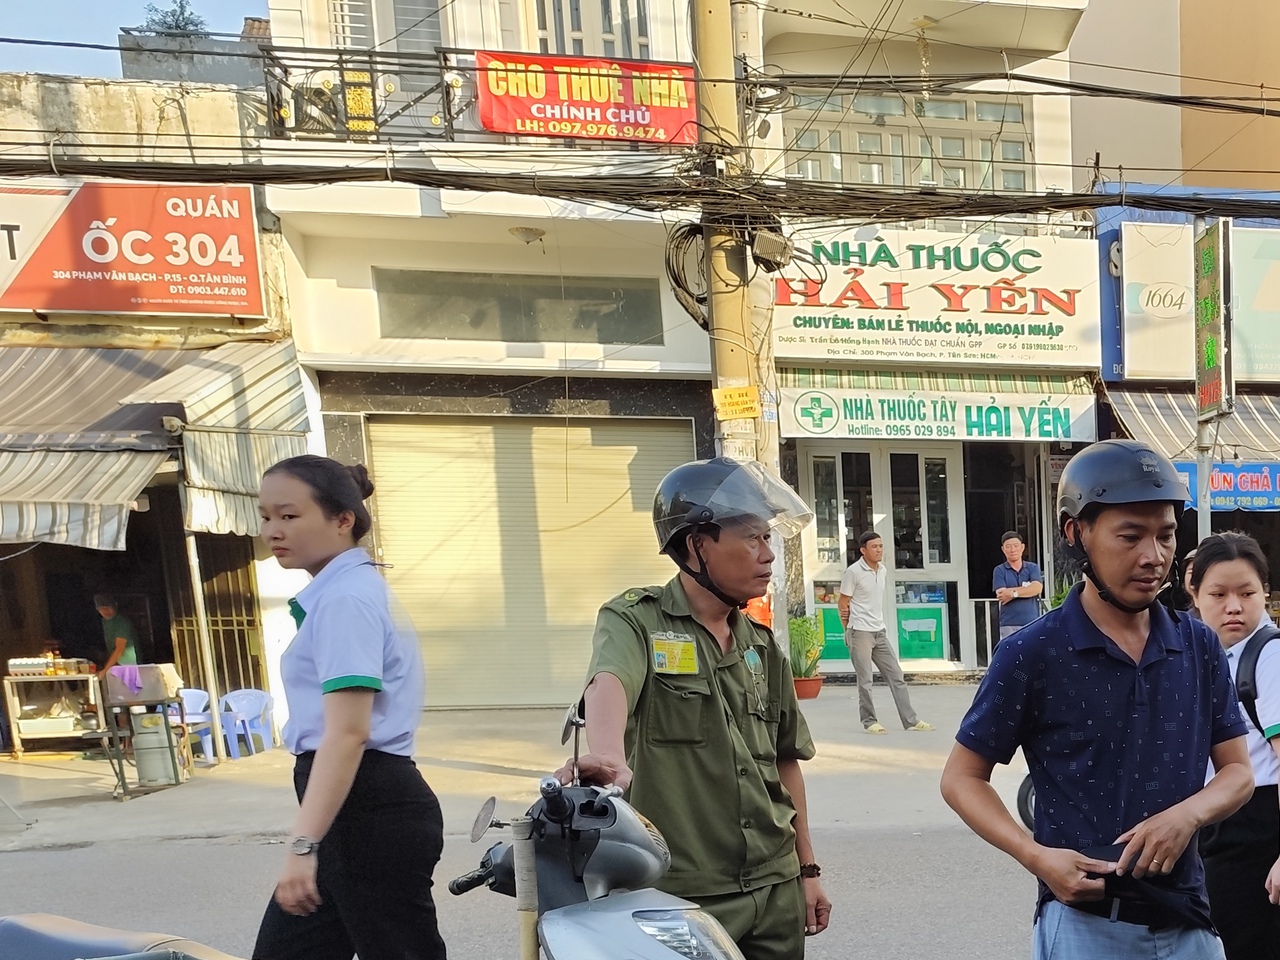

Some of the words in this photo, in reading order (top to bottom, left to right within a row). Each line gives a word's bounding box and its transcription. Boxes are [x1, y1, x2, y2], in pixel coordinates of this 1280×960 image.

[487, 60, 546, 99] CHO
[553, 64, 625, 104] THUÊ
[633, 69, 689, 109] NHÀ
[530, 101, 601, 121] CHÍNH
[606, 105, 651, 125] CHỦ
[516, 118, 545, 132] LH:
[547, 120, 667, 140] 097.976.9474
[165, 195, 240, 219] QUÁN
[82, 217, 155, 265] ỐC
[164, 232, 245, 267] 304
[811, 235, 900, 269] NHÀ
[905, 238, 1043, 274] THUỐC
[53, 270, 71, 280] 304
[72, 270, 103, 282] PHẠM
[103, 270, 127, 281] VĂN
[127, 272, 157, 284] BẠCH
[164, 273, 182, 283] P.15
[189, 272, 222, 284] Q.TÂN
[222, 273, 247, 285] BÌNH
[169, 284, 186, 295] ĐT:
[187, 285, 247, 297] 0903.447.610
[774, 267, 910, 311] HẢI
[928, 273, 1082, 317] YẾN
[1144, 287, 1188, 311] 1664
[792, 314, 855, 330] CHUYÊN:
[857, 315, 886, 331] BÁN
[887, 314, 905, 332] LẺ
[906, 315, 952, 334] THUỐC
[955, 319, 982, 338] NỘI,
[984, 322, 1025, 339] NGOẠI
[1027, 322, 1065, 340] NHẬP
[876, 350, 898, 358] Phạm
[881, 337, 898, 346] NHÀ
[898, 336, 923, 347] THUỐC
[924, 338, 938, 348] ĐẠT
[940, 337, 966, 348] CHUẨN
[968, 340, 983, 349] GPP
[842, 393, 875, 421] NHÀ
[880, 391, 927, 422] THUỐC
[931, 396, 958, 422] TÂY
[965, 396, 1011, 437] HẢI
[1017, 395, 1072, 439] YẾN
[847, 423, 883, 436] Hotline:
[885, 424, 911, 436] 0965
[914, 424, 933, 437] 029
[936, 425, 956, 437] 894
[1143, 465, 1161, 474] Royal
[1209, 468, 1233, 492] ÚN
[1237, 466, 1272, 492] CHẢ
